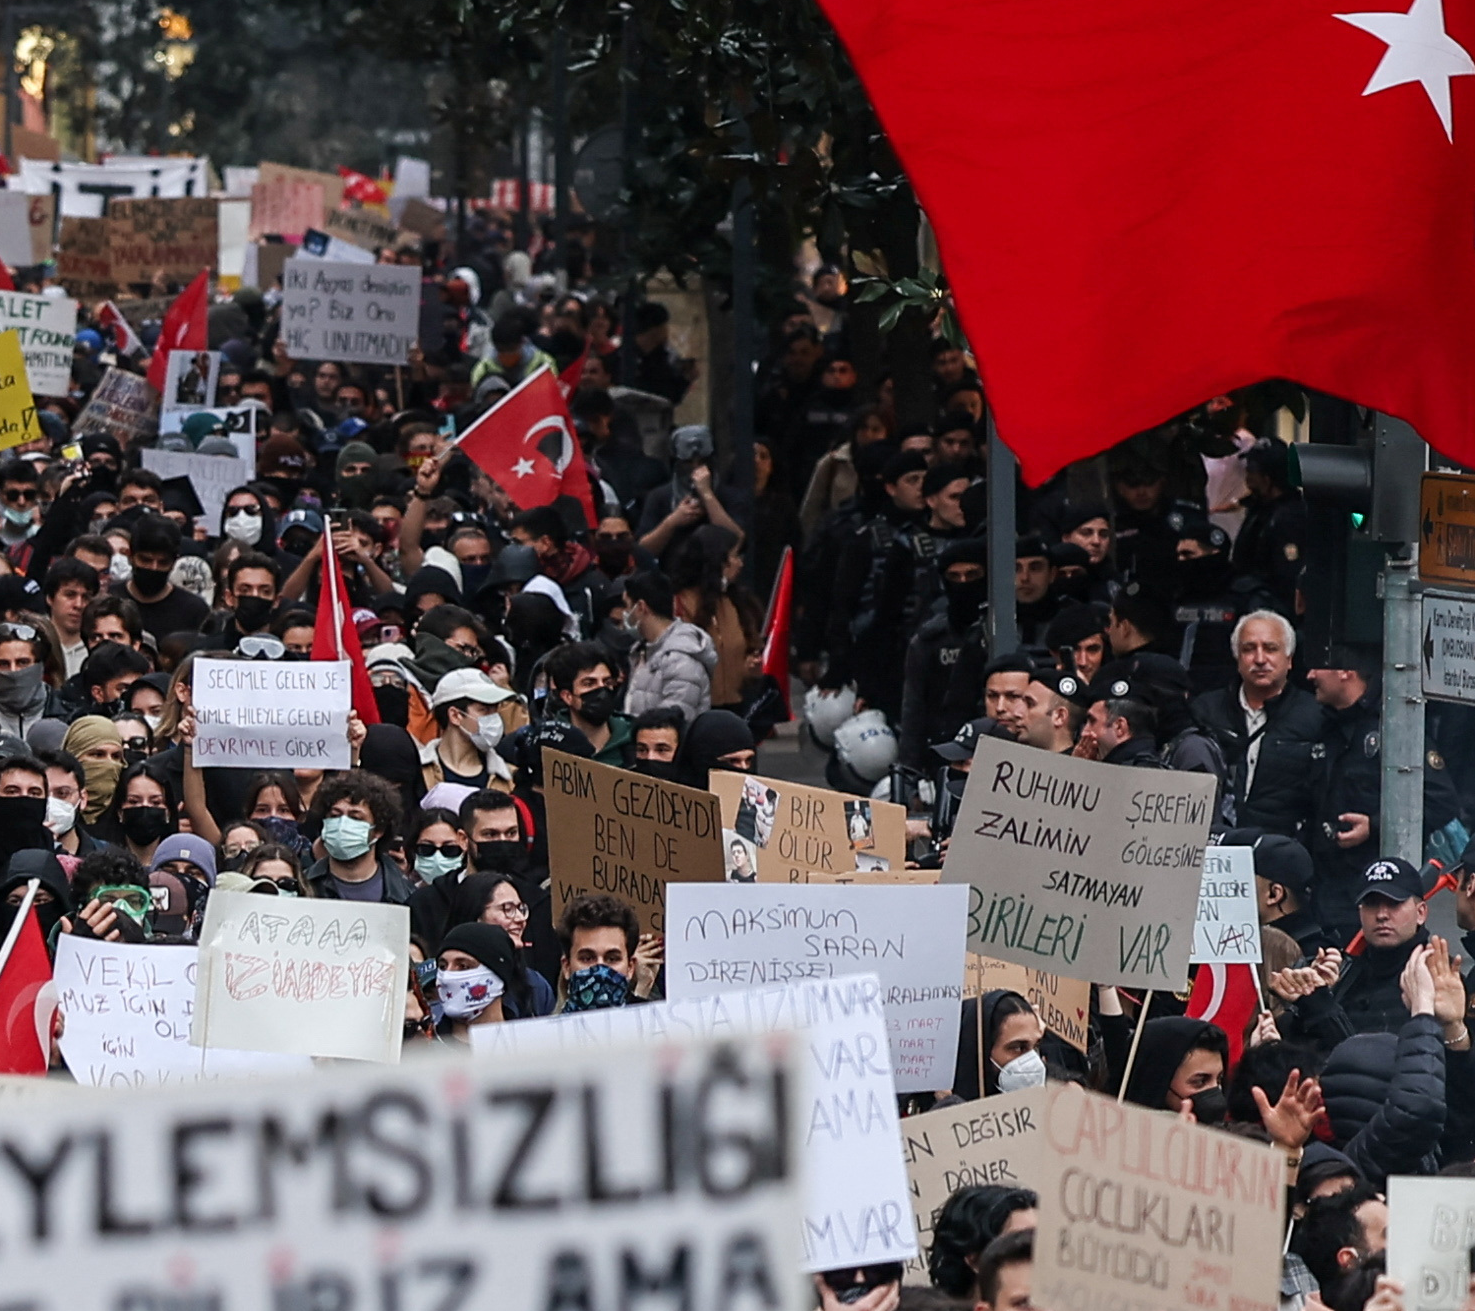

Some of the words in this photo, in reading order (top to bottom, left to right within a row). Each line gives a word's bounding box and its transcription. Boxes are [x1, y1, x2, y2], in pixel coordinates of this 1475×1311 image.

[329, 298, 354, 322] Biz
[275, 669, 316, 691] GELEN
[287, 707, 332, 727] GELEN
[285, 736, 330, 758] GİDER
[551, 758, 597, 804] ABİM
[991, 760, 1101, 812] RUHUNU
[1125, 790, 1208, 830] ŞEREFİNİ
[790, 793, 826, 833] BİR
[594, 812, 636, 861] BEN
[654, 833, 681, 874] DE
[778, 828, 834, 871] ÖLÜR
[974, 809, 1092, 857] ZALİMİN
[1121, 836, 1204, 869] GÖLGESİNE
[1041, 869, 1144, 909] SATMAYAN
[684, 903, 858, 942] MAKSİMUM
[967, 885, 1088, 966] BİRİLERİ
[1119, 922, 1172, 979] VAR
[804, 933, 905, 961] SARAN
[75, 950, 174, 989] VEKİL
[882, 984, 962, 1007] IRALAMASI
[907, 1017, 945, 1031] MART
[809, 1034, 890, 1082] VAR
[899, 1038, 937, 1050] MART
[899, 1054, 936, 1067] MART
[952, 1106, 1037, 1149] DEĞİŞİR
